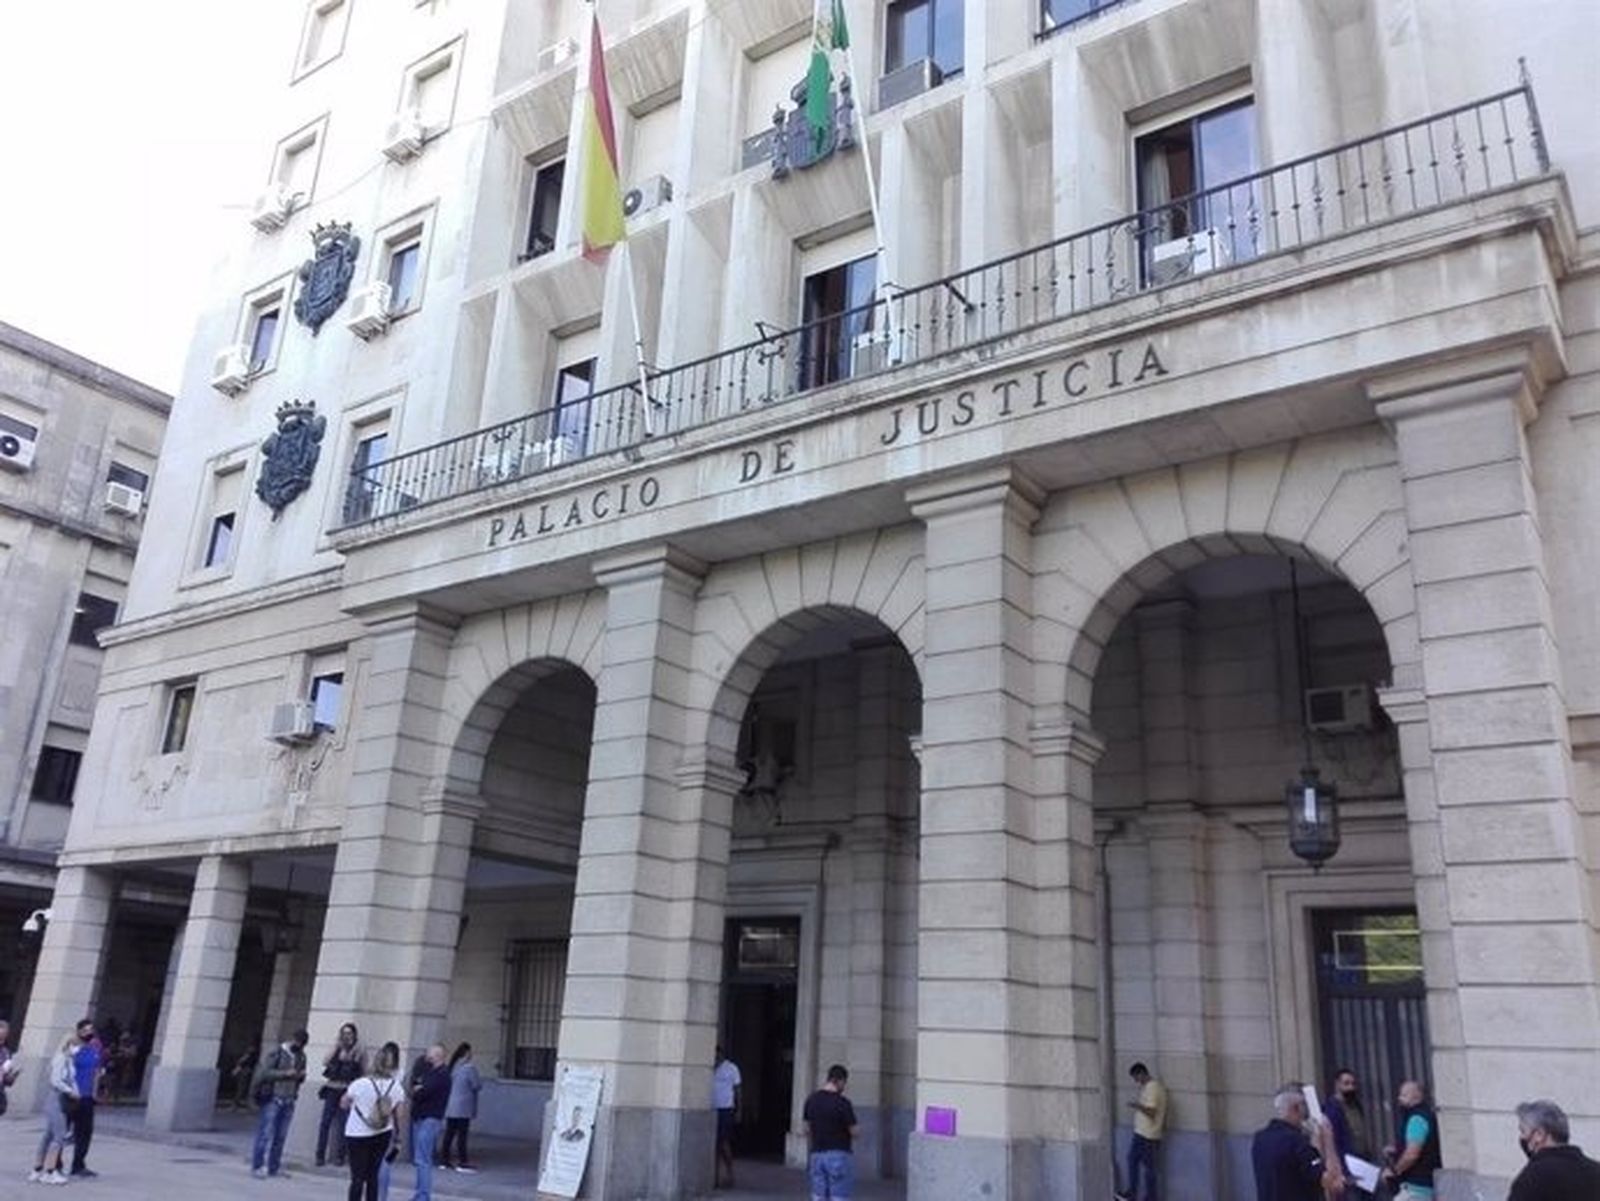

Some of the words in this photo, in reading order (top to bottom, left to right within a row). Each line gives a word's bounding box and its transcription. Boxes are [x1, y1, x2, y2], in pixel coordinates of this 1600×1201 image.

[488, 477, 660, 546] PALACIO
[740, 440, 796, 483] DE
[881, 344, 1169, 445] JUSTICIA
